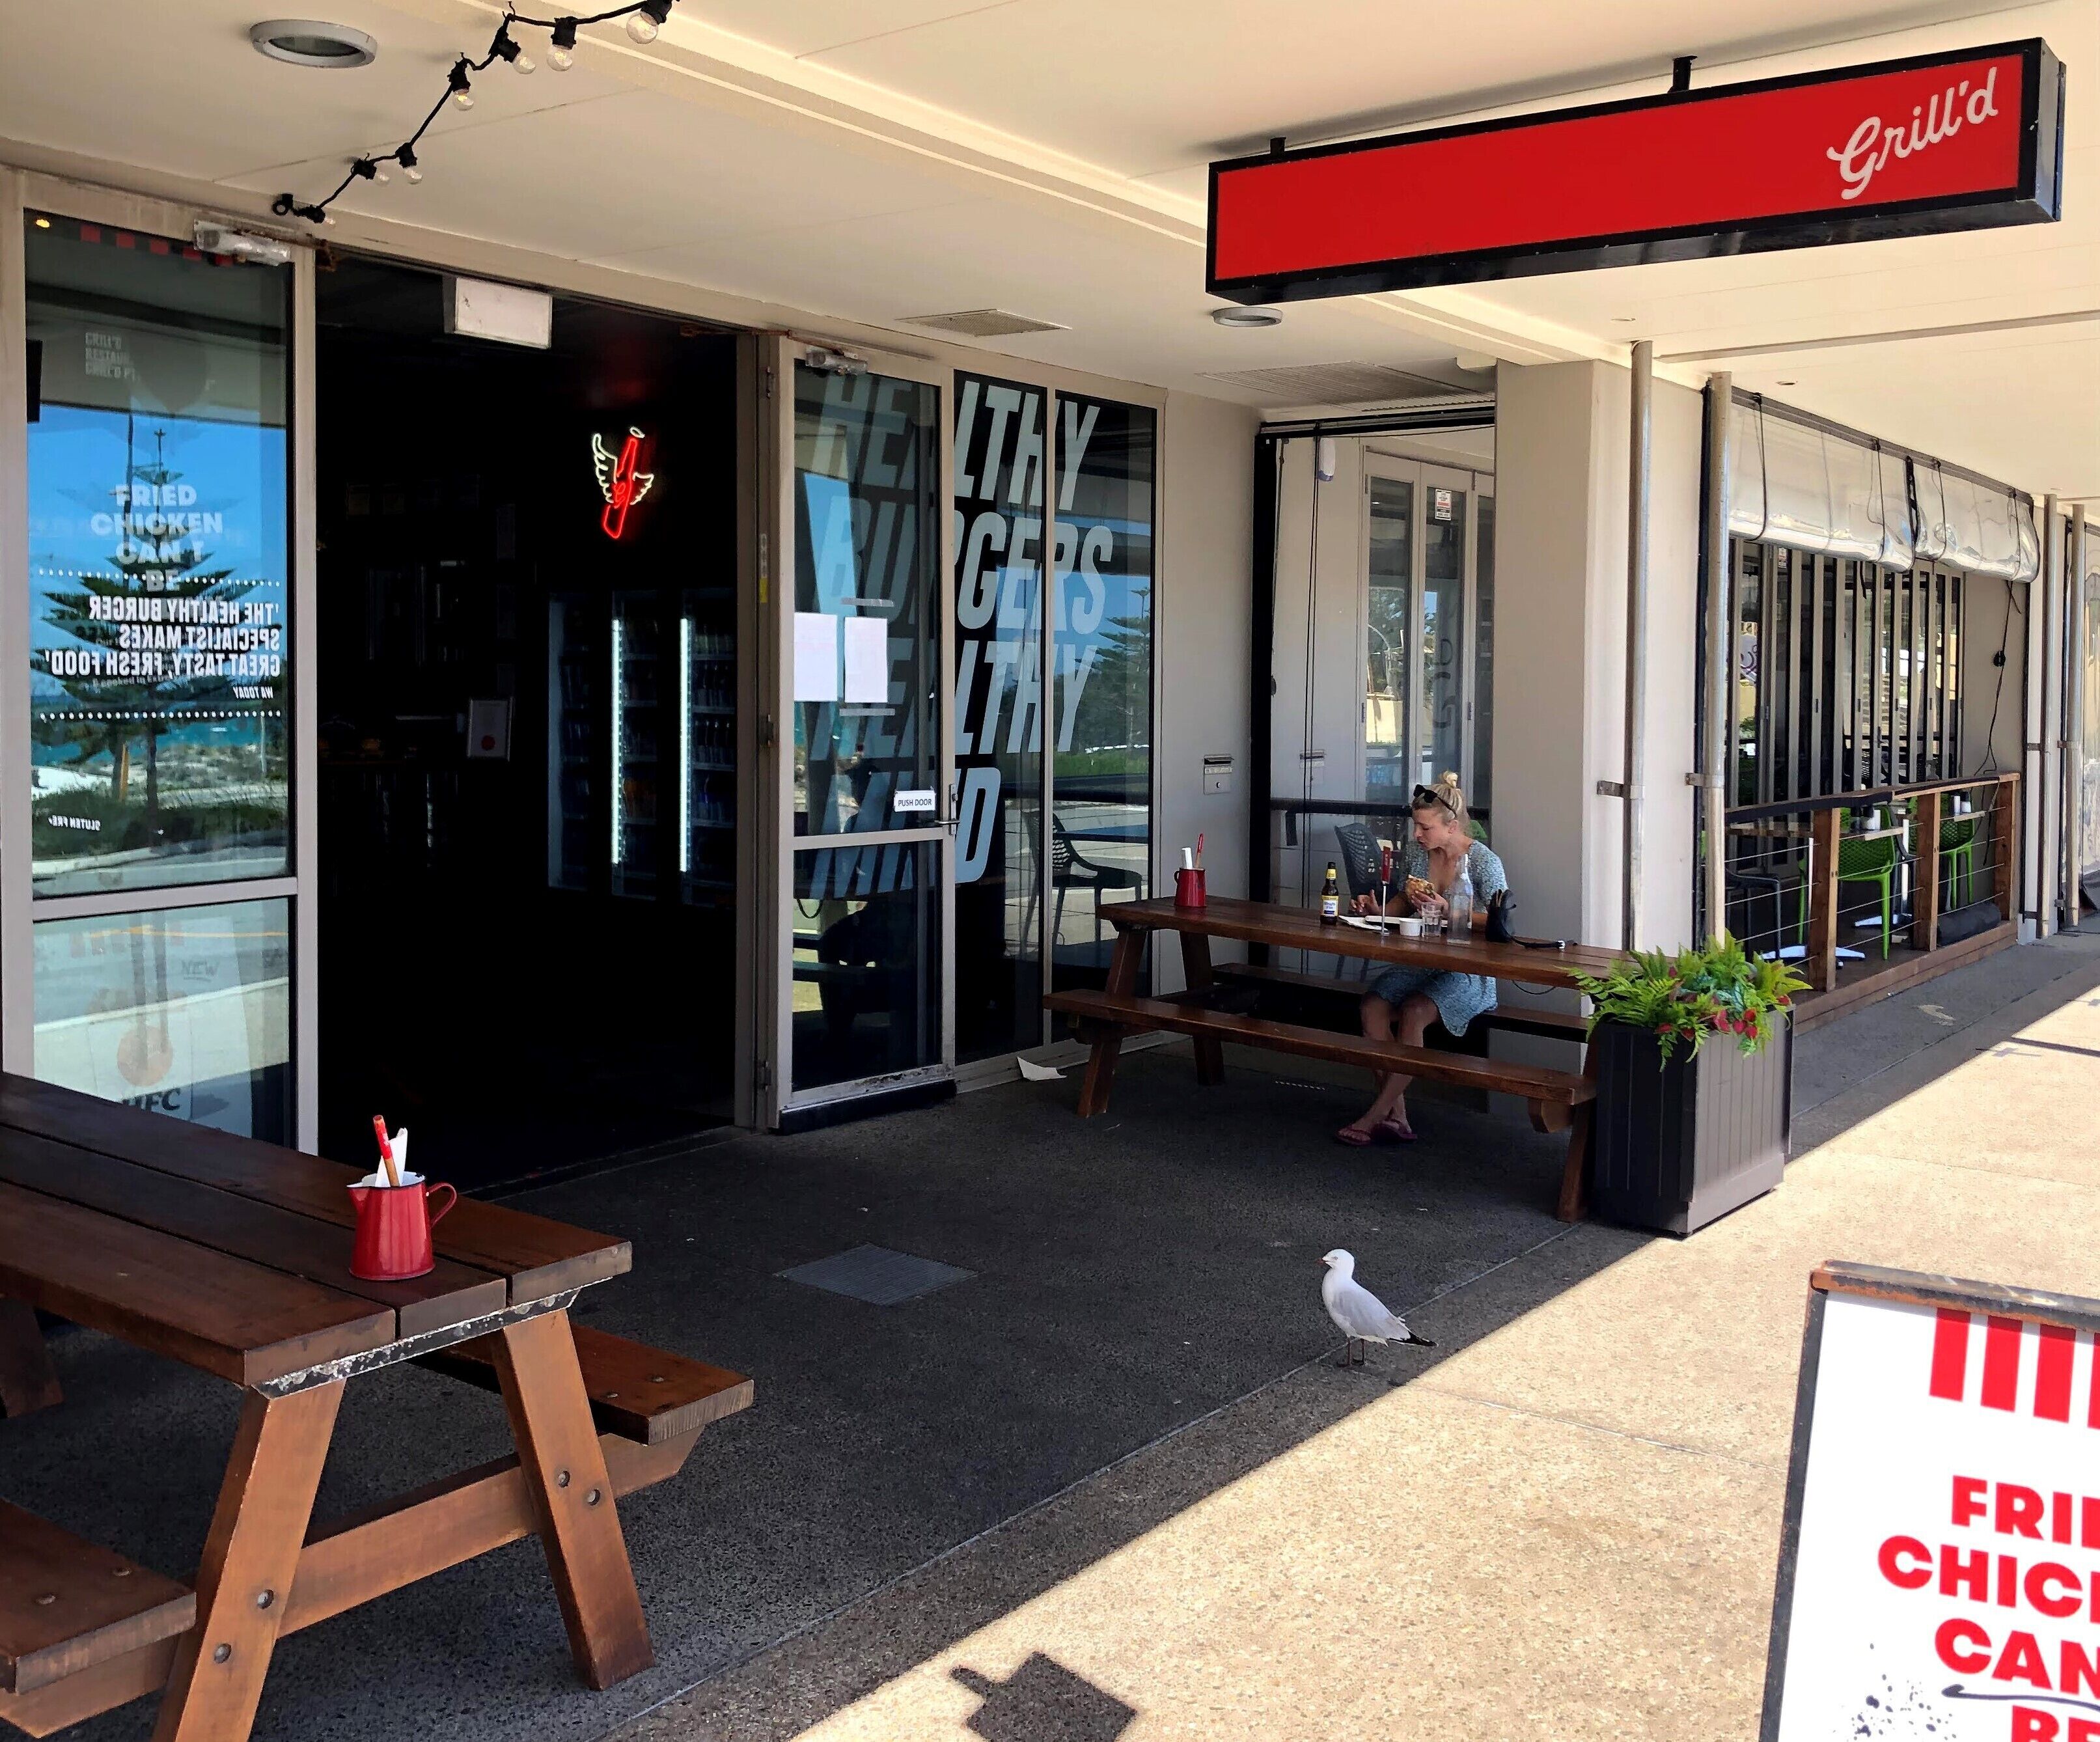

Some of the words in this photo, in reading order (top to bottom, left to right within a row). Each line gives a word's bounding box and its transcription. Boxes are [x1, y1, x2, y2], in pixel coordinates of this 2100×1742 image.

[1826, 66, 1998, 200] Grill'd
[116, 484, 197, 506] FRIED
[90, 512, 223, 536] CHICKEN
[116, 540, 204, 564] CANT
[146, 569, 180, 591] BE
[810, 638, 1096, 760] ELTHY
[809, 767, 1001, 900] MID
[1878, 1535, 2100, 1624] CHIC
